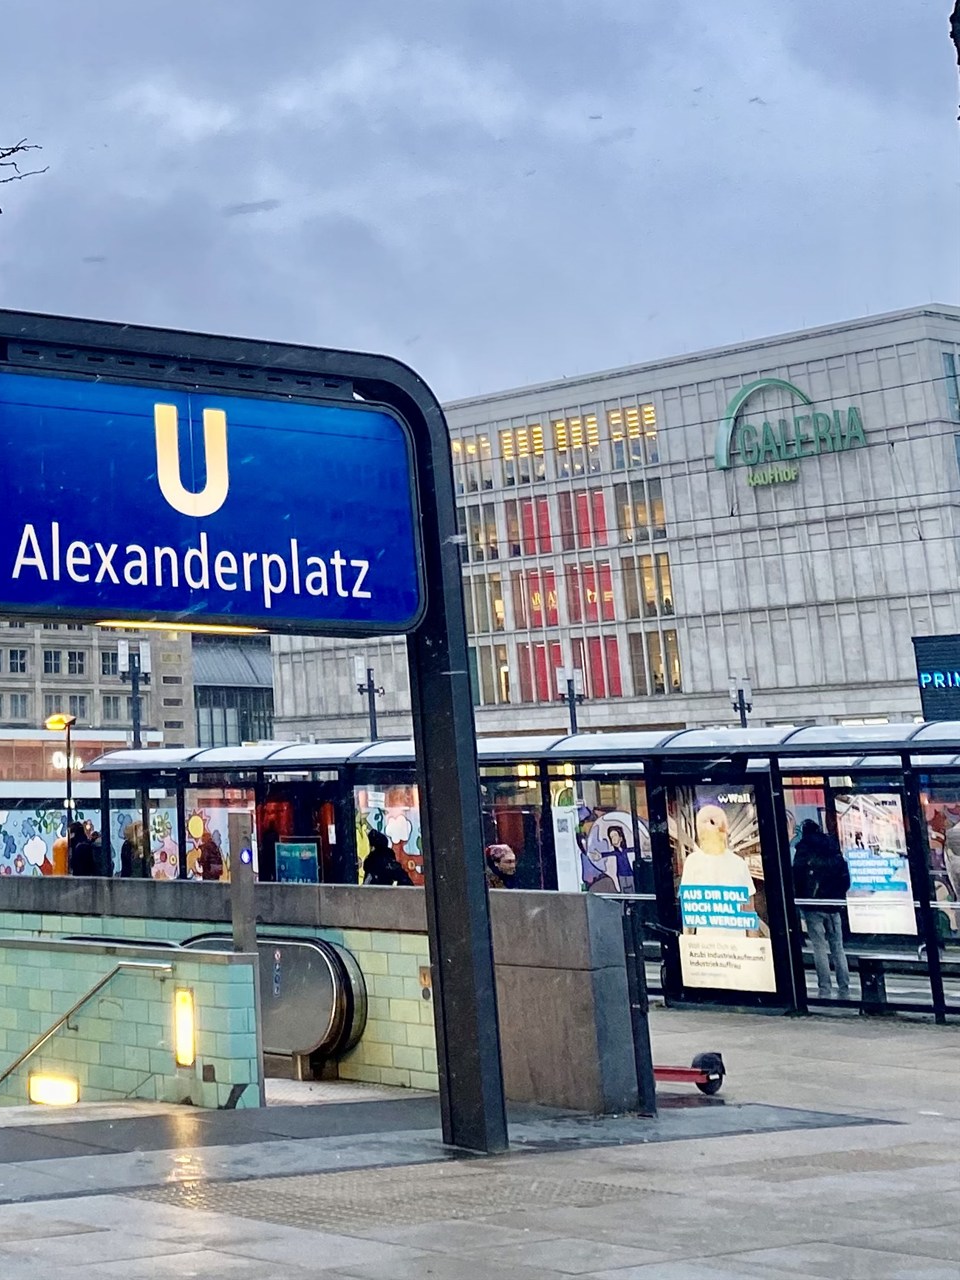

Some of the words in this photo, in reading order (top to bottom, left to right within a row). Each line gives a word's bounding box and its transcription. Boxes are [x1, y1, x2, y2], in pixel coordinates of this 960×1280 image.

[737, 407, 867, 466] GALERIA
[153, 403, 229, 517] U
[746, 465, 799, 487] KAUFHOF
[11, 521, 372, 609] Alexanderplatz
[683, 889, 702, 900] AUS
[704, 889, 722, 900] DIR
[723, 890, 747, 902] SOLL
[684, 902, 711, 912] NOCH
[713, 902, 735, 914] MAL
[685, 914, 707, 925] WAS
[709, 915, 755, 928] WERDEN?
